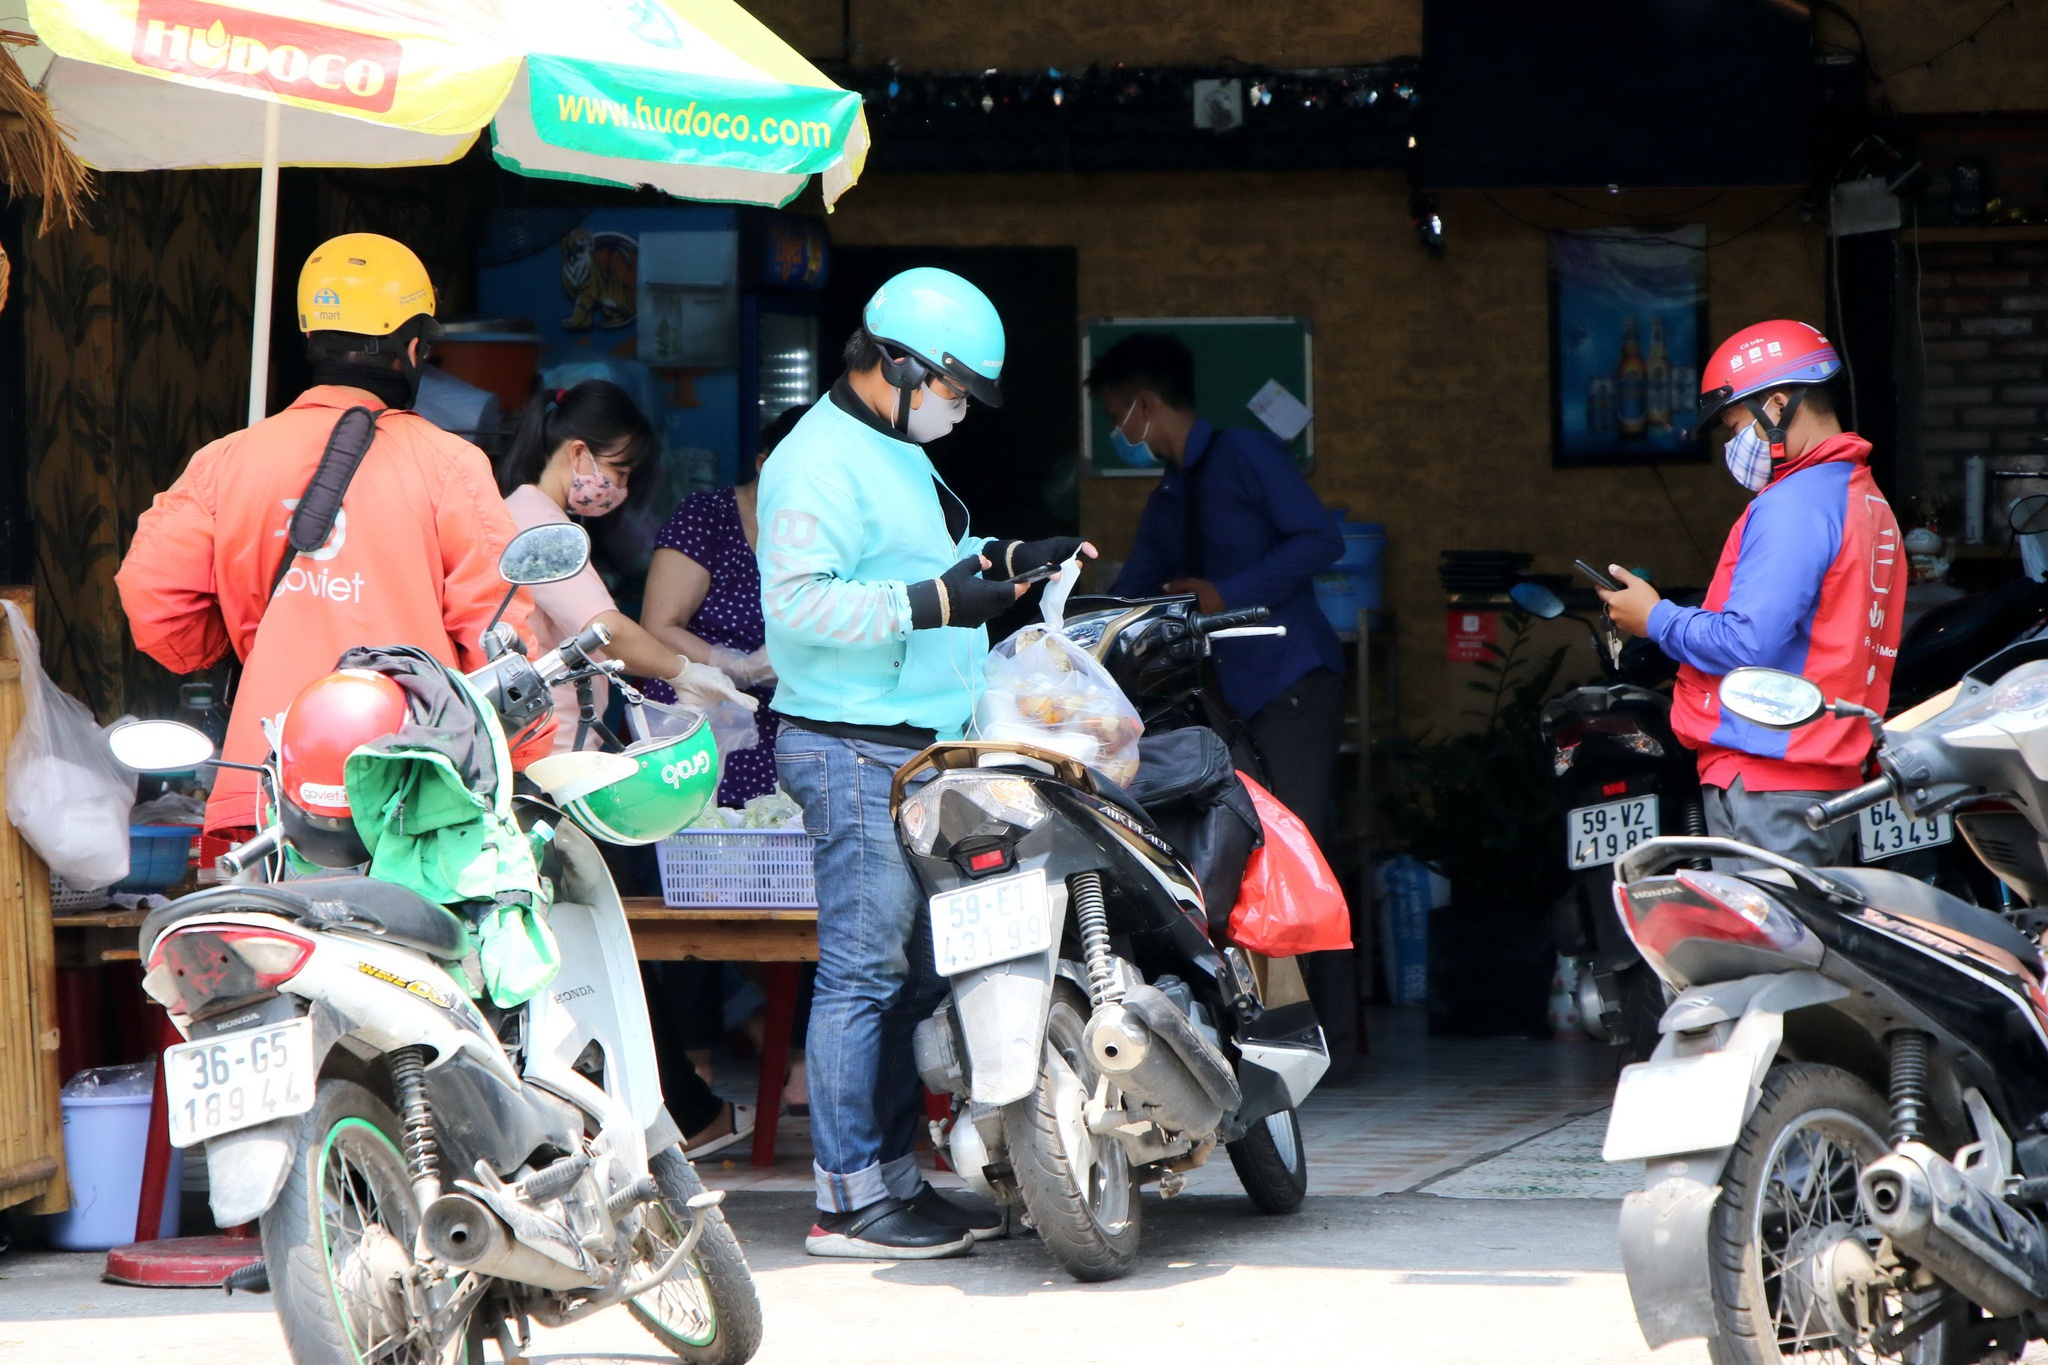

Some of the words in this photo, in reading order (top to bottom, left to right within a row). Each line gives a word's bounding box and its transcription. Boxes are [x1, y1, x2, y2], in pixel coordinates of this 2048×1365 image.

[144, 19, 385, 97] HUDOCO
[557, 94, 831, 148] www.hudoco.com
[661, 750, 710, 789] Grab
[1582, 802, 1645, 835] 59-V2
[1874, 820, 1939, 852] 4349
[949, 882, 1024, 929] 59-E1
[1631, 886, 1684, 899] HONDA
[553, 985, 597, 1005] HONDA
[216, 1012, 261, 1032] HONDA
[189, 1031, 288, 1090] 36-G5
